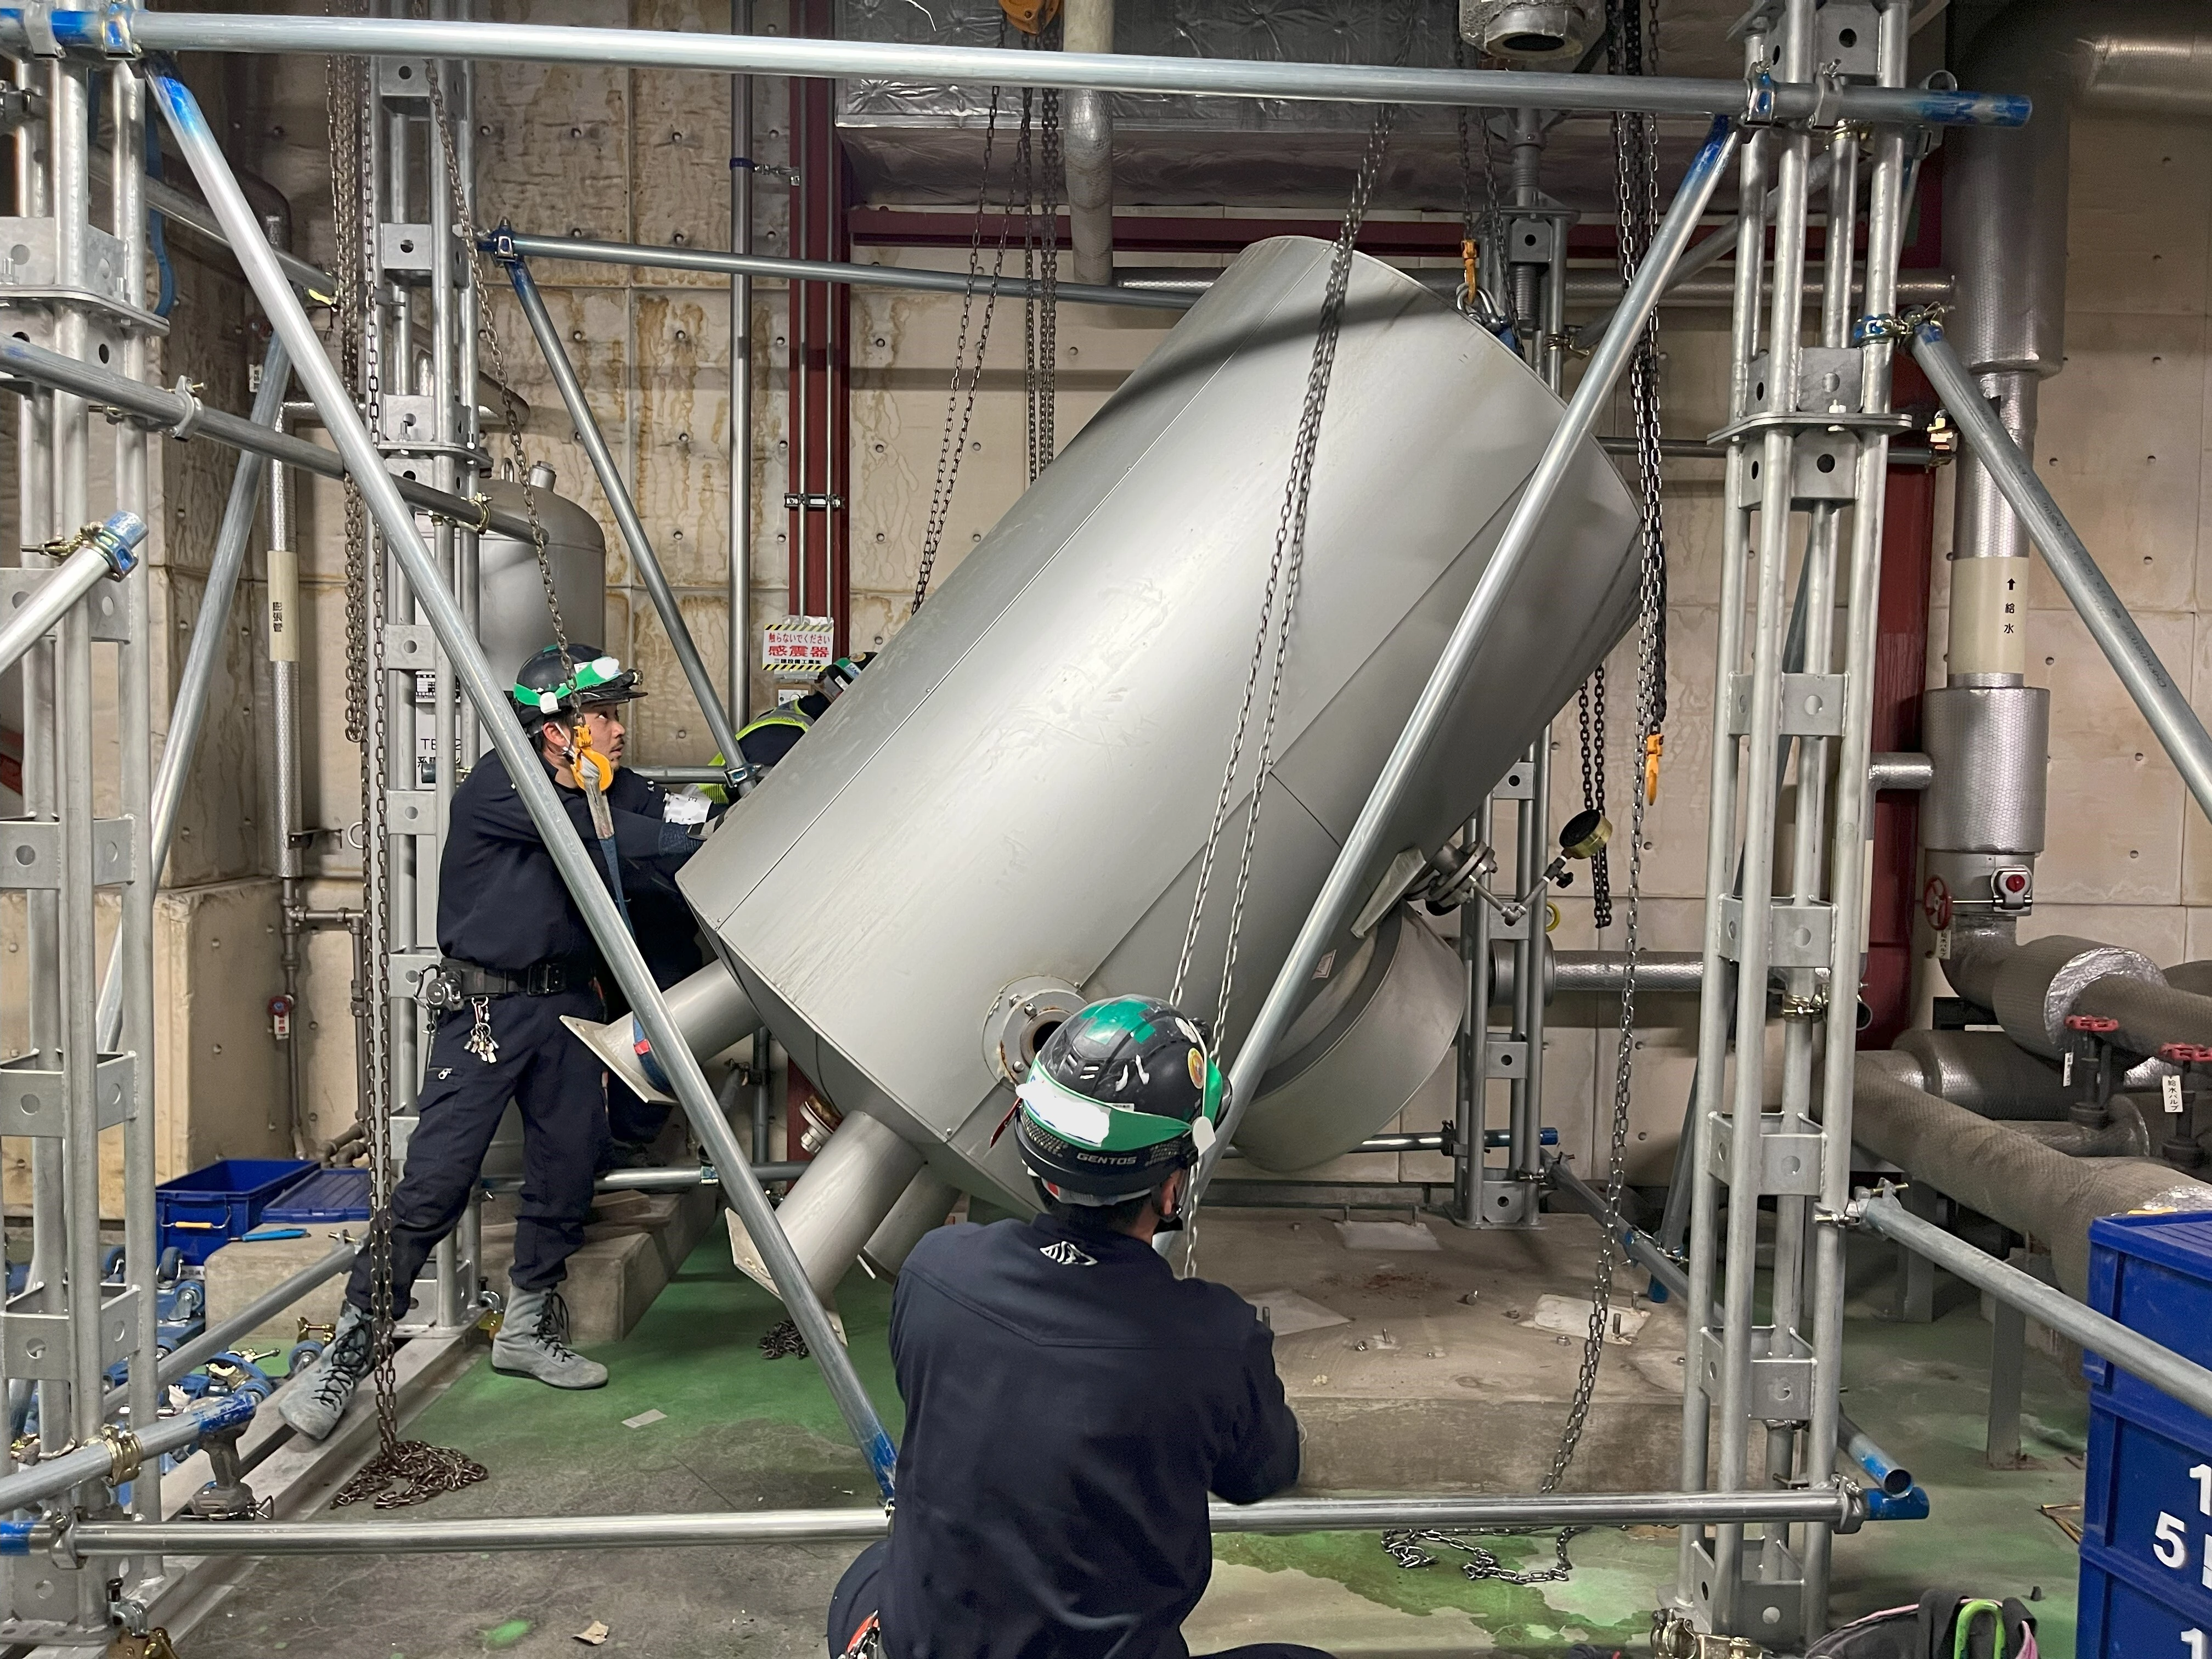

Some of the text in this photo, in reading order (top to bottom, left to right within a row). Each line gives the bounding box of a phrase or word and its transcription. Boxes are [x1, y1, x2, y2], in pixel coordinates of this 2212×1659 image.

[2004, 602, 2015, 634] 給水
[769, 632, 830, 644] 触らないでください
[768, 645, 830, 657] 感震器
[1077, 1152, 1137, 1165] GENTOS
